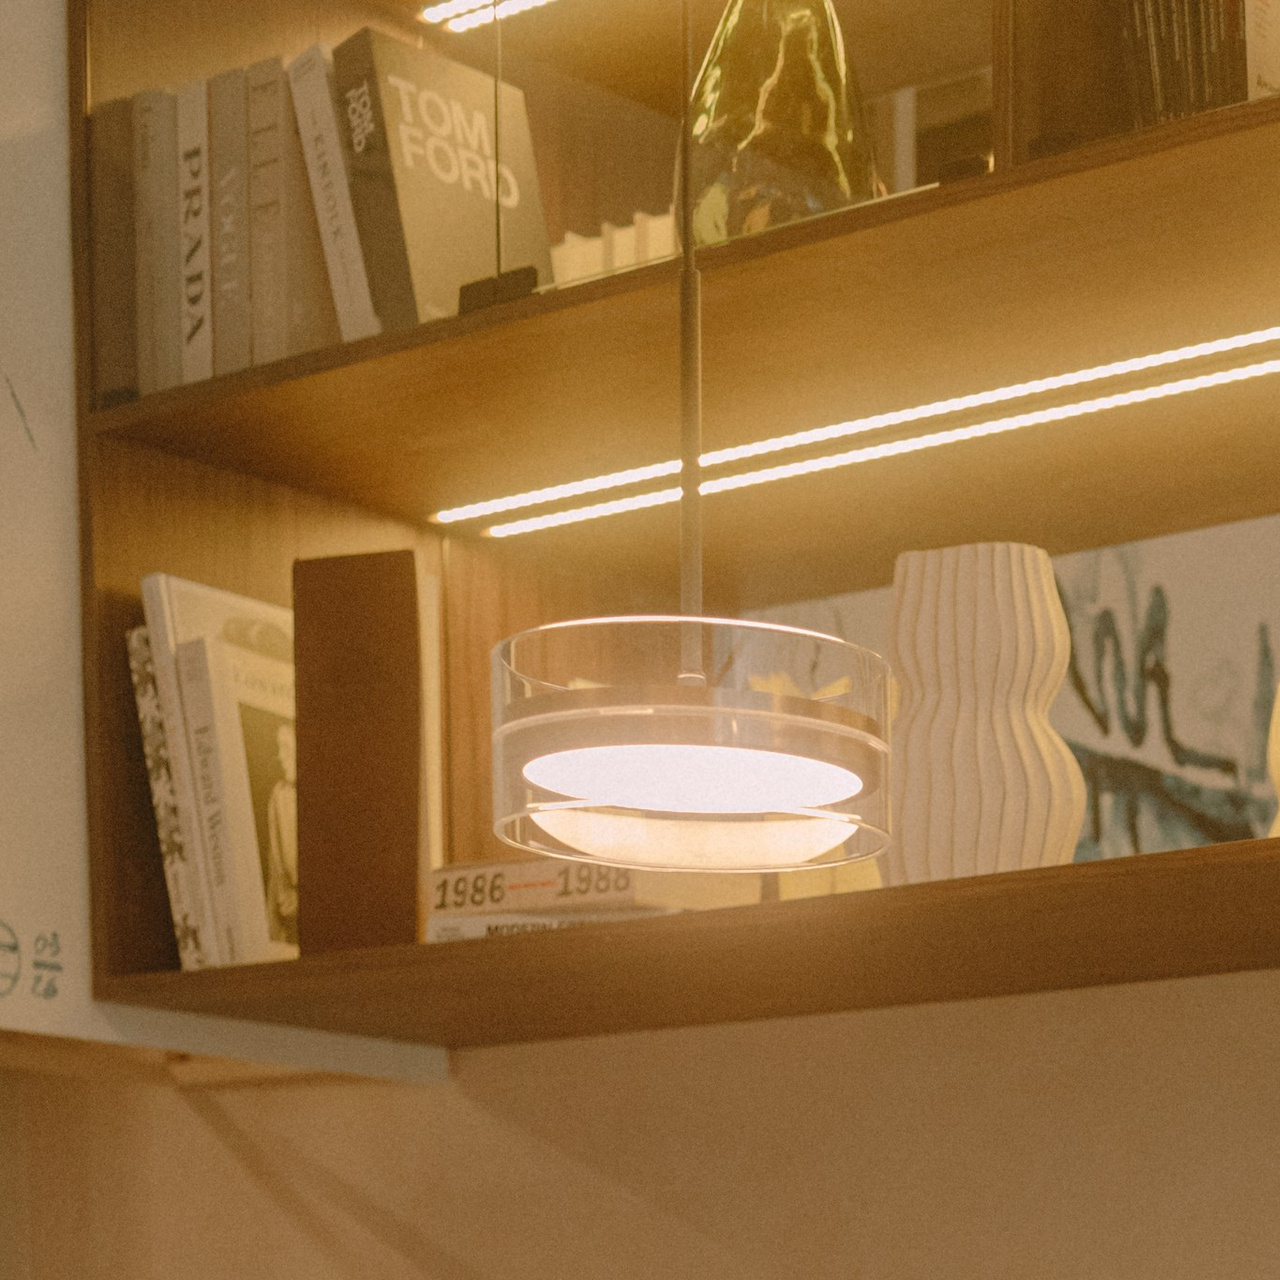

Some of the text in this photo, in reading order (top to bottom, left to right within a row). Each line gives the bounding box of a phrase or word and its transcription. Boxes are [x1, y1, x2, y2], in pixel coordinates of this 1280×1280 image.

[357, 80, 375, 134] TOM
[388, 75, 491, 158] TOM
[399, 122, 519, 209] FORD
[183, 146, 205, 345] PRADA
[434, 871, 507, 911] 1986
